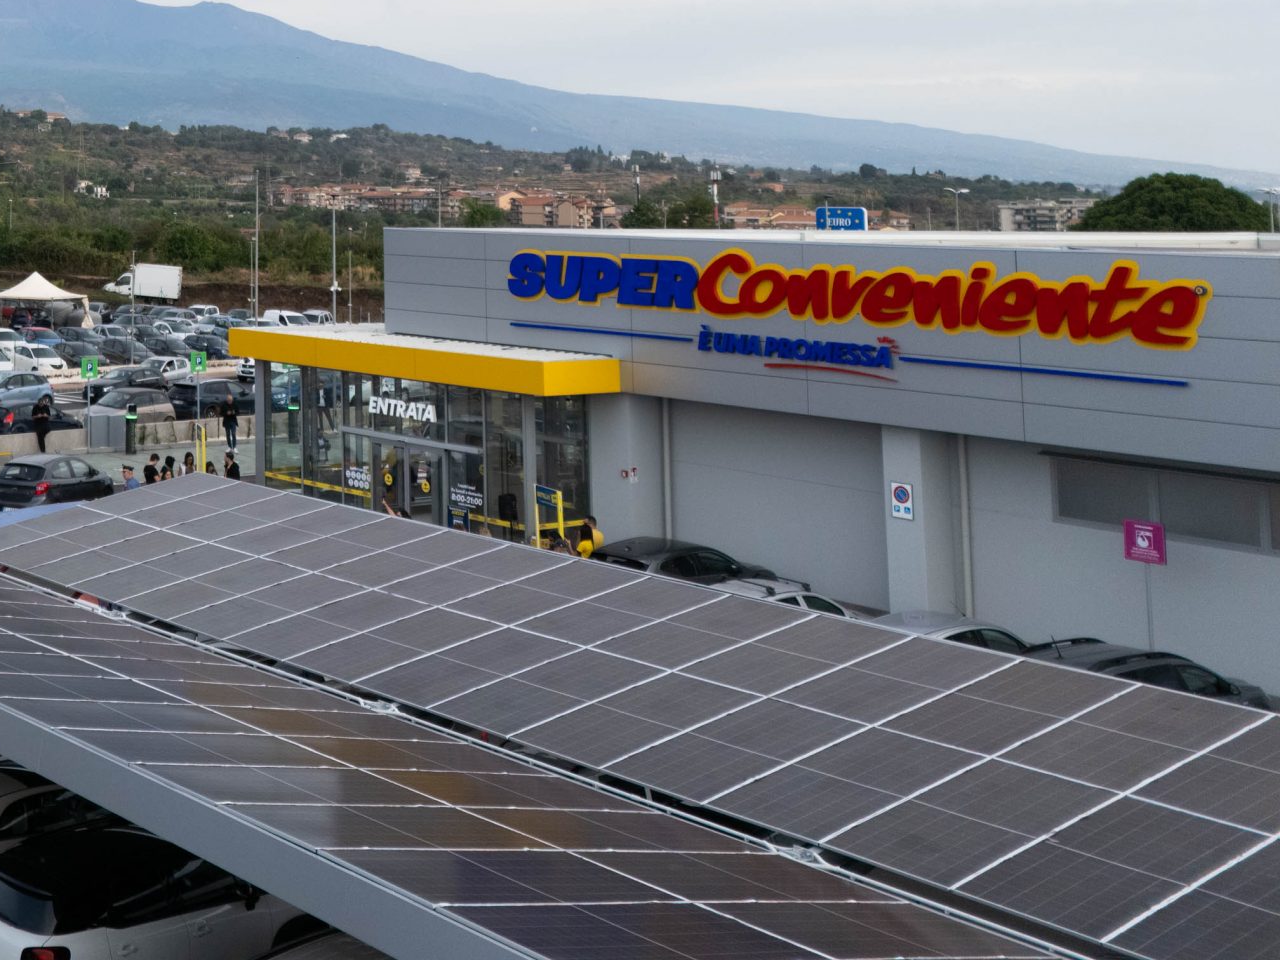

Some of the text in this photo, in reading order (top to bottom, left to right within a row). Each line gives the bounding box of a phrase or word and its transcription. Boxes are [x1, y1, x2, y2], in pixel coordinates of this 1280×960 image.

[827, 217, 851, 227] EURO
[713, 332, 762, 357] UNA
[764, 336, 893, 369] PROMESSA
[368, 396, 437, 423] ENTRATA
